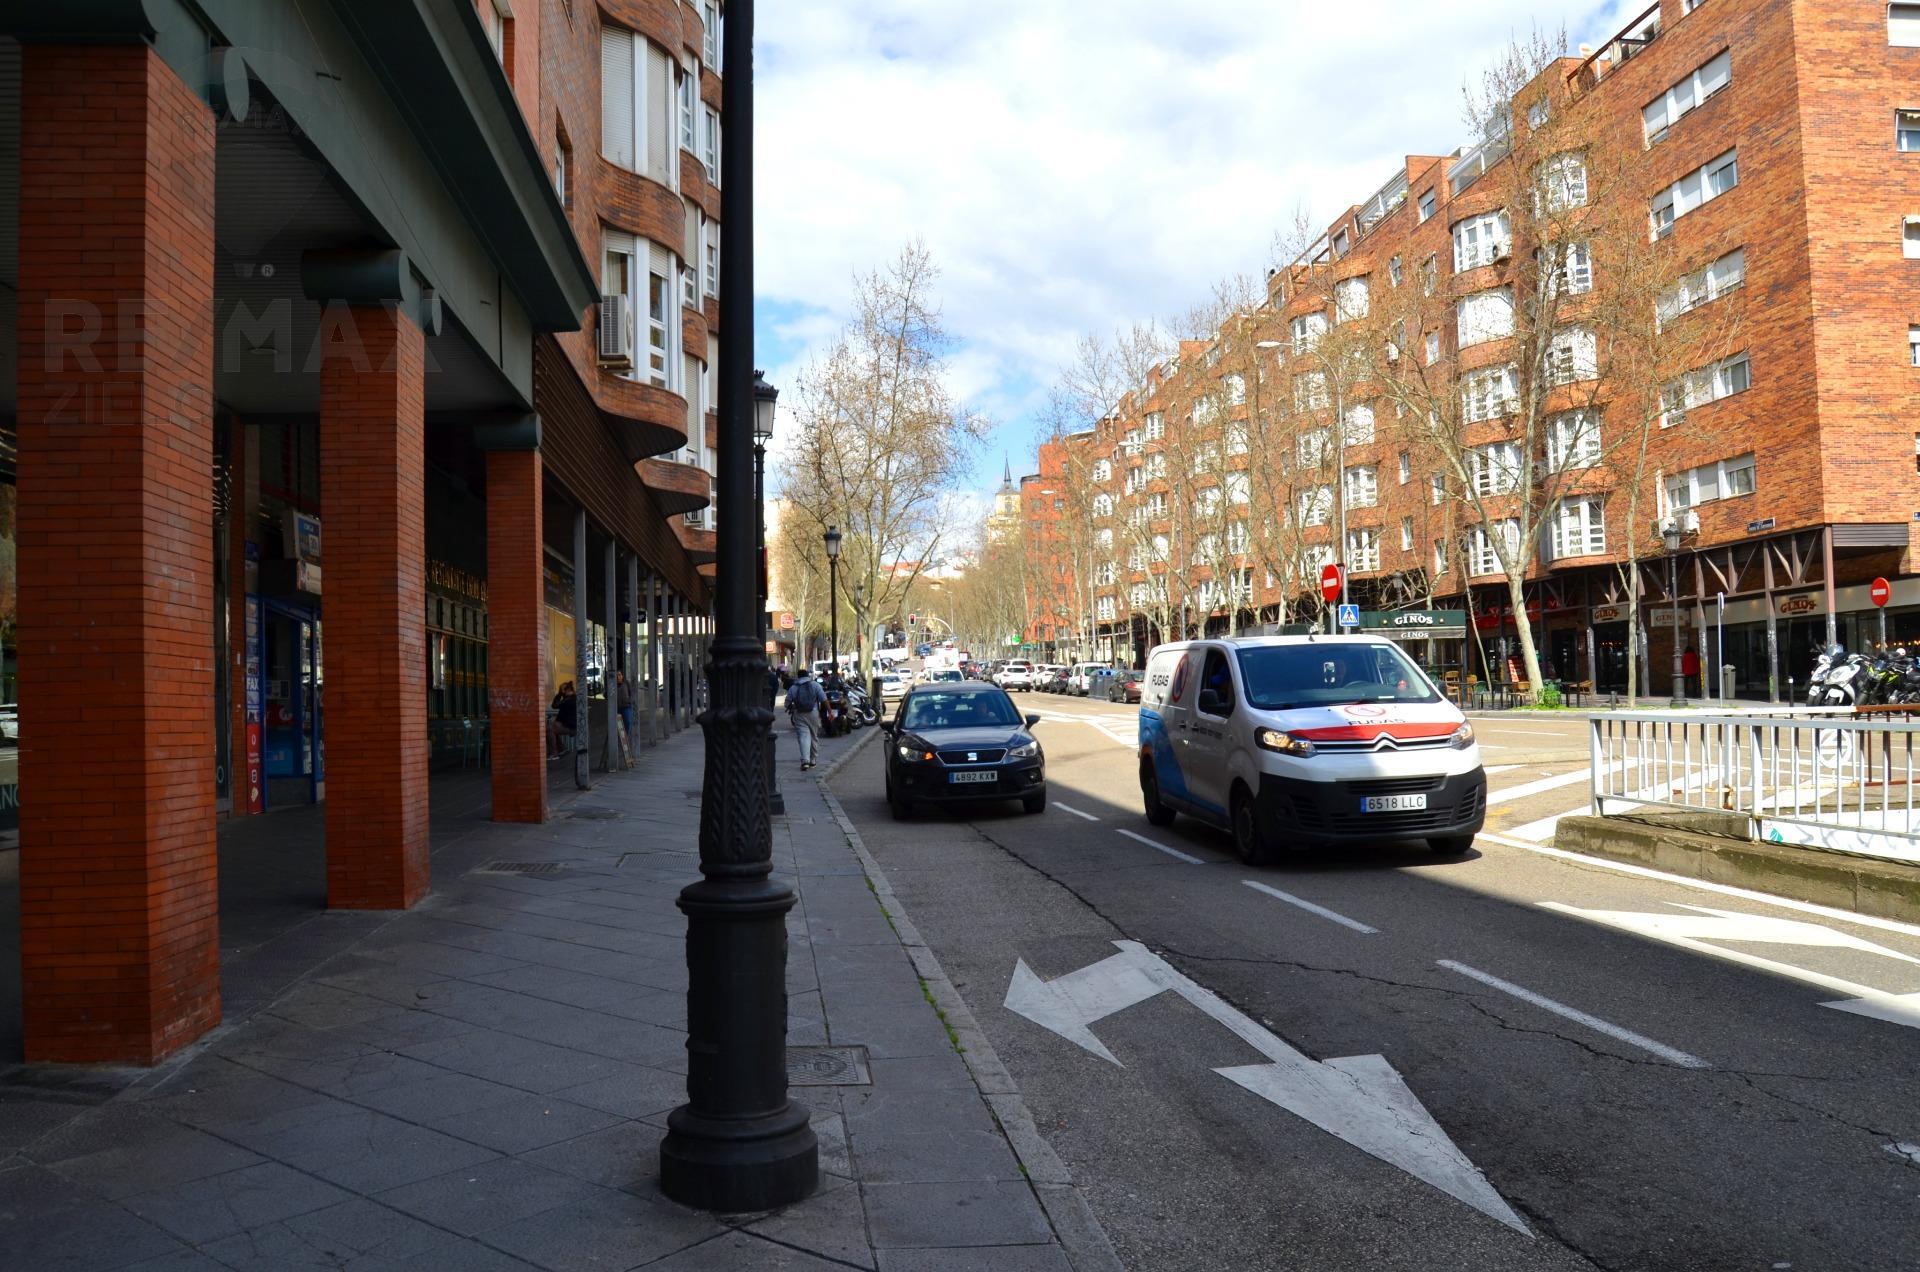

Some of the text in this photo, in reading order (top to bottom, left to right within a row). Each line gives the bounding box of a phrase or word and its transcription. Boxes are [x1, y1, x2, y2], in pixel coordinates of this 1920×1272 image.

[1780, 600, 1817, 613] GINOS
[1394, 615, 1433, 625] GINOS
[1152, 674, 1170, 686] FUGAS
[1368, 796, 1424, 810] 6518 LLC
